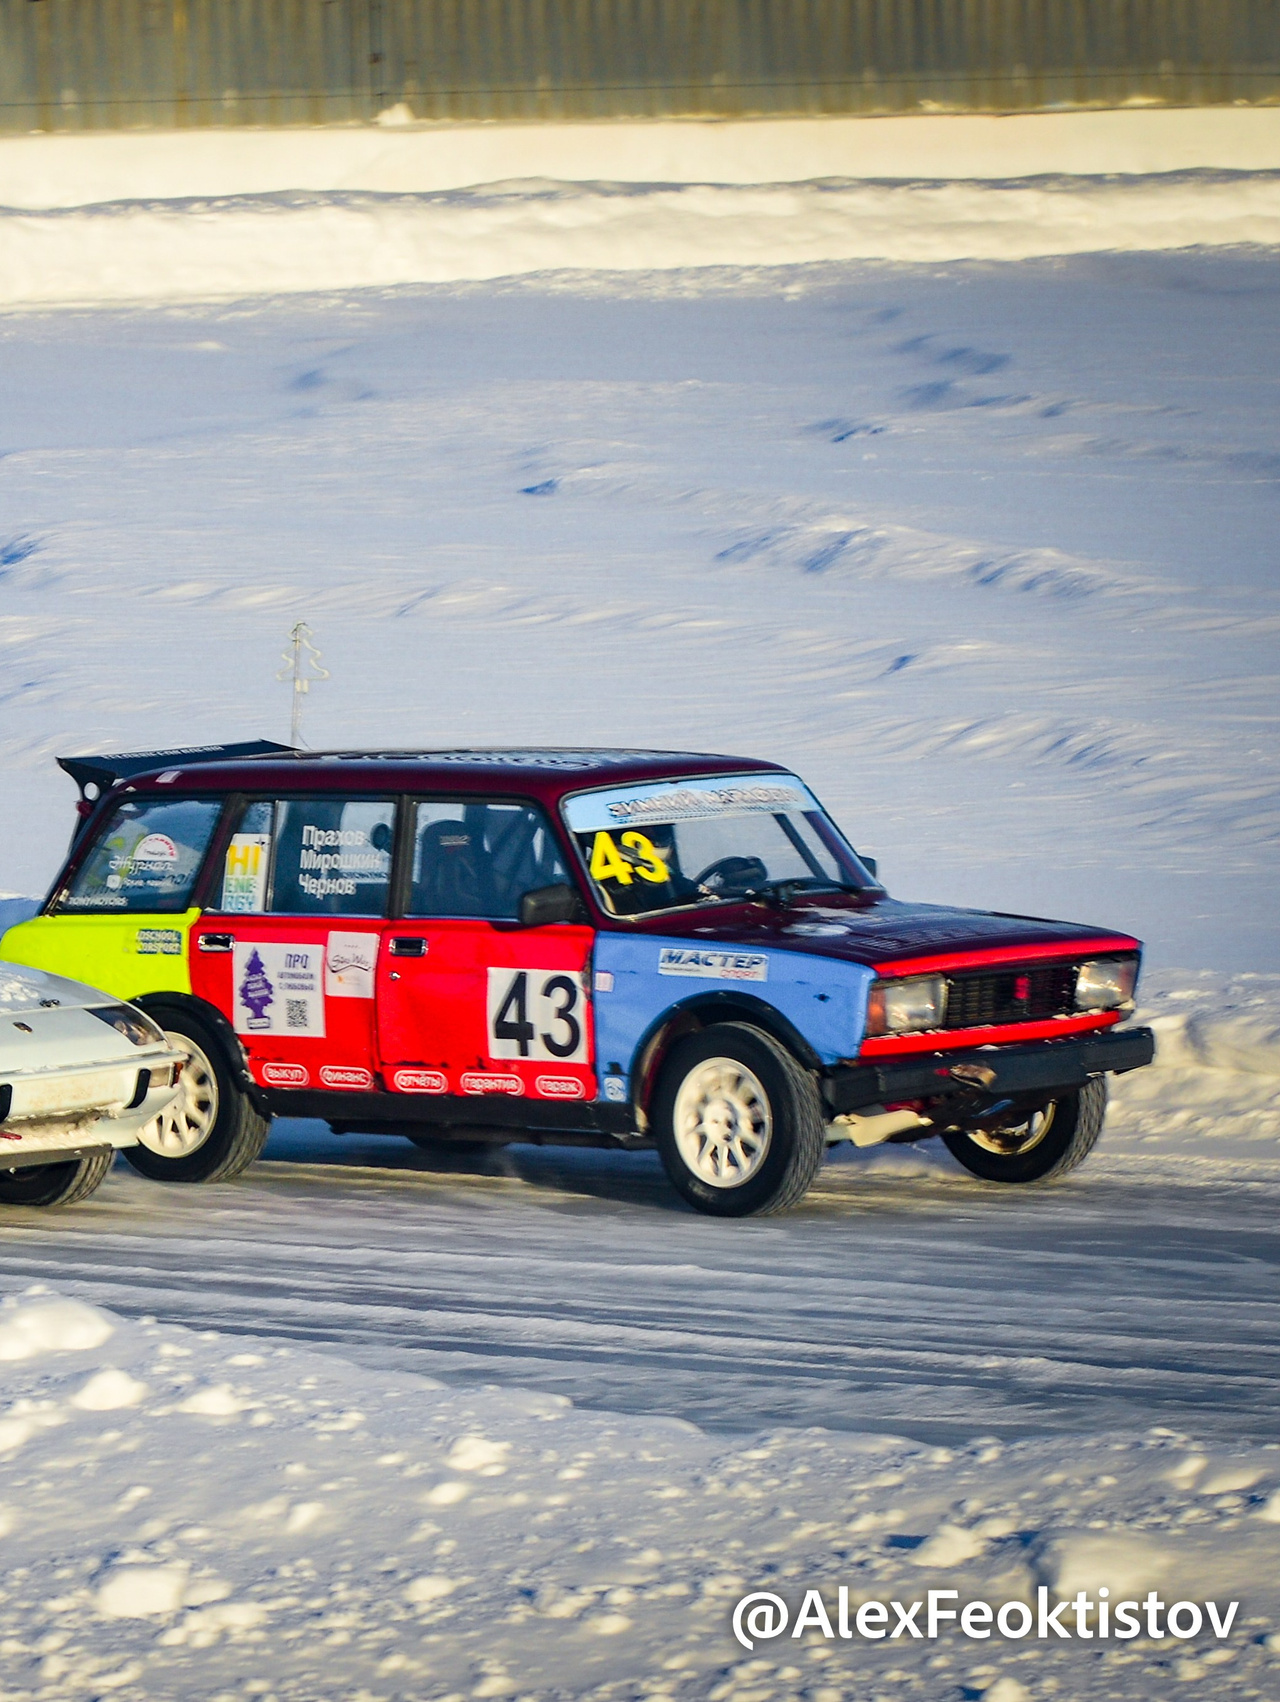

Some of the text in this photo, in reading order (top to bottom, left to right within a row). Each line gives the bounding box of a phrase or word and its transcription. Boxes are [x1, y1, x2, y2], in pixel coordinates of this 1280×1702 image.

[607, 789, 698, 818] ЗИМНИЙ
[301, 825, 365, 851] Прахов
[227, 845, 262, 876] HI
[300, 850, 382, 873] Мирошкин
[591, 831, 669, 885] 43
[299, 873, 357, 899] Чернов
[285, 953, 310, 969] ПРО
[661, 950, 765, 968] МАСТЕР
[494, 971, 581, 1058] 43
[268, 1067, 304, 1080] выкуп
[324, 1068, 368, 1083] финанс
[465, 1078, 519, 1090] гарантия
[540, 1080, 579, 1093] гараж
